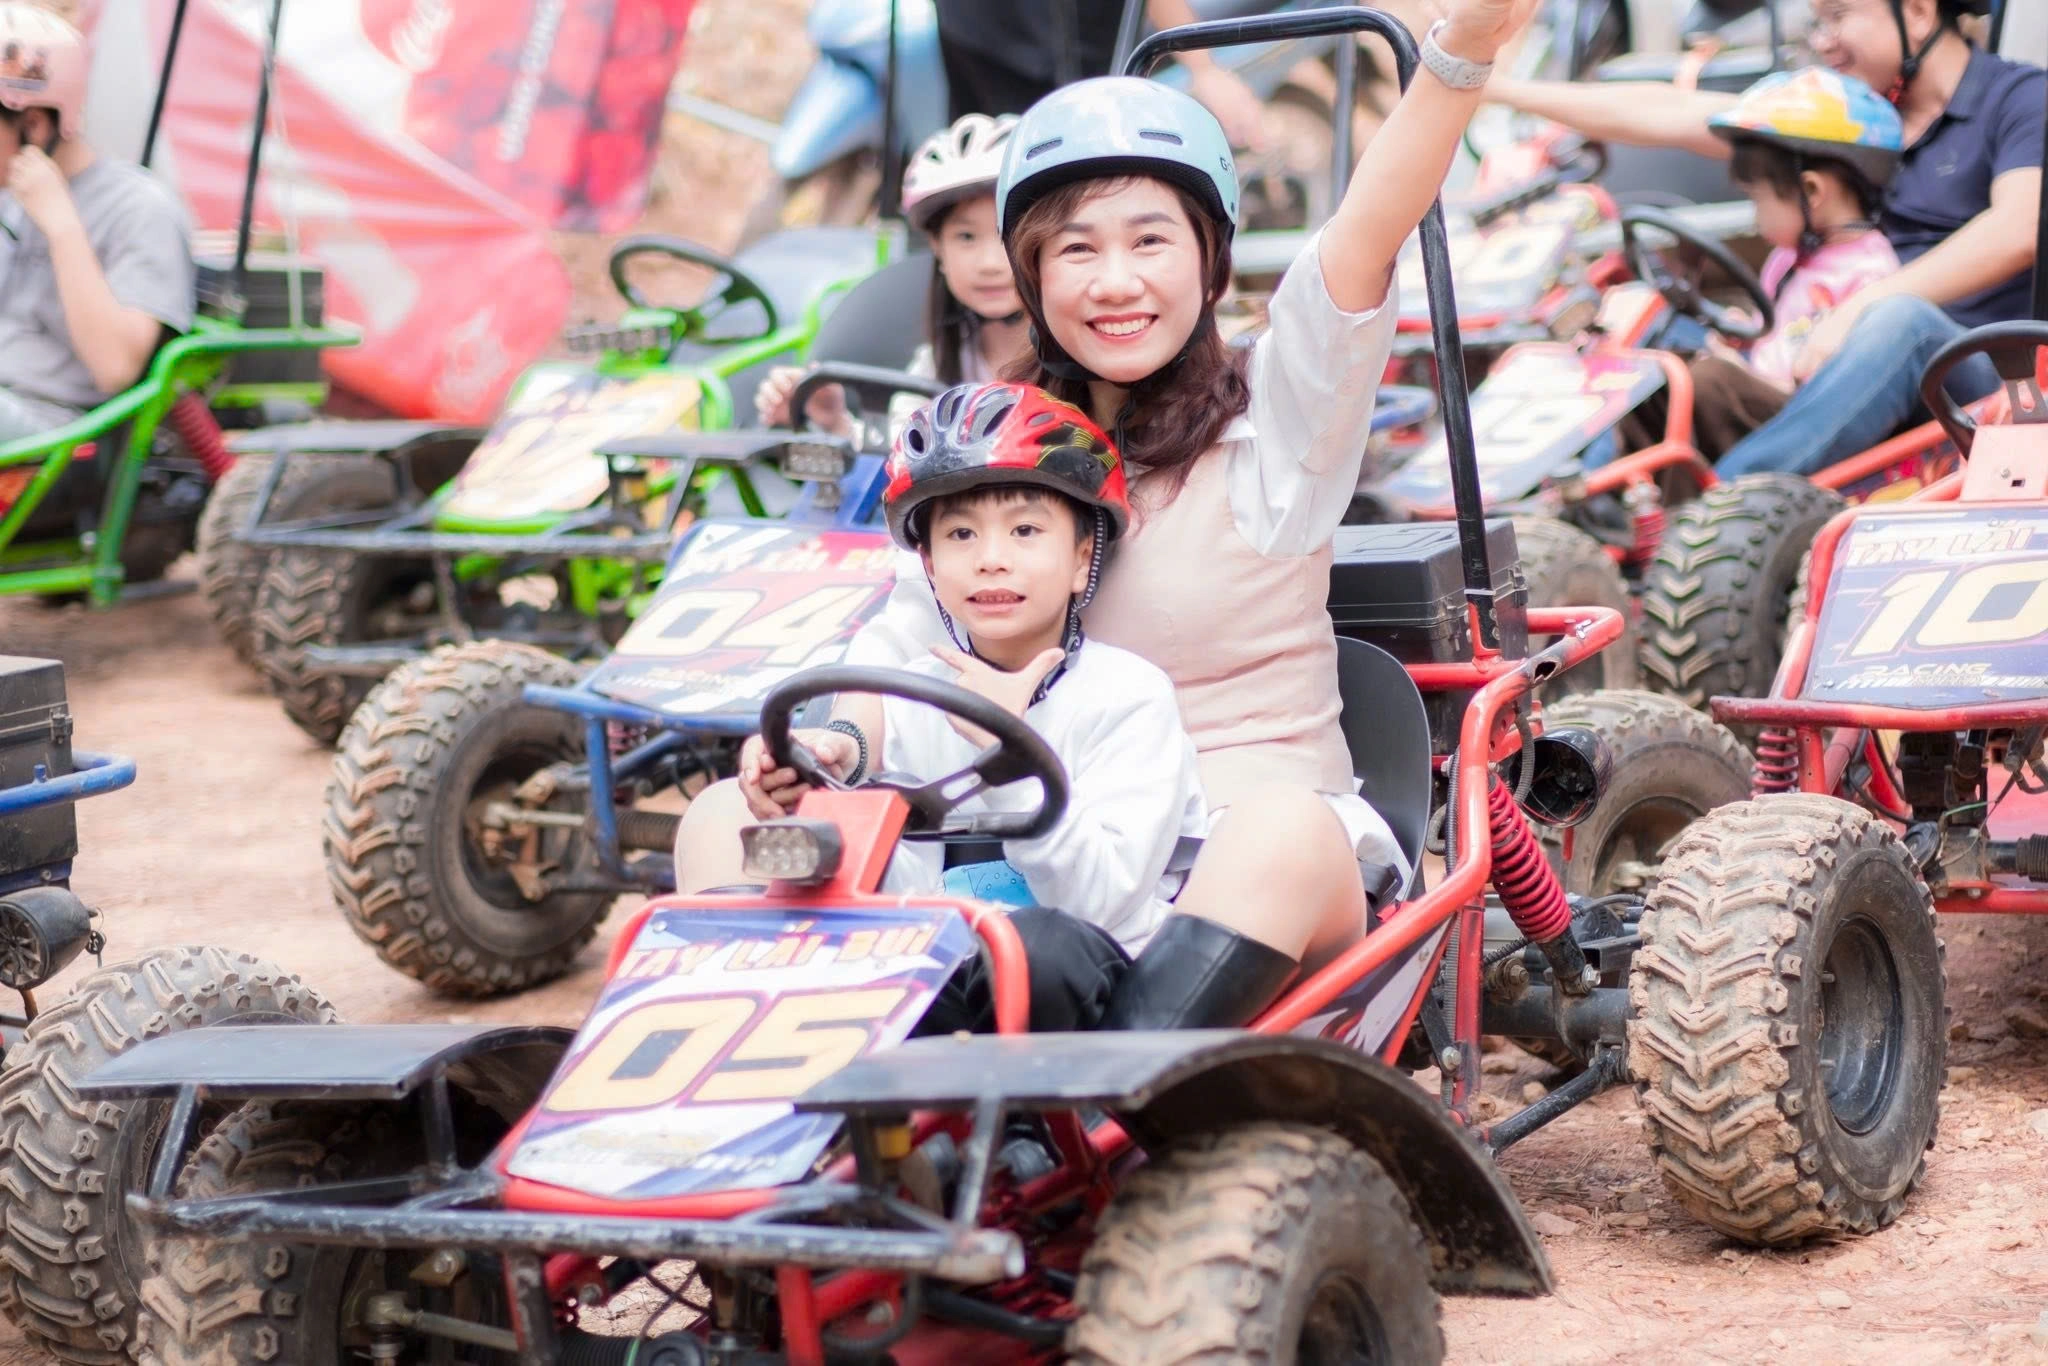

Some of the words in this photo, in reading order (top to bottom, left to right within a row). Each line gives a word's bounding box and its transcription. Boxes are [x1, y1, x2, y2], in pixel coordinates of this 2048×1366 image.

[1847, 536, 1938, 567] TAY
[615, 585, 876, 666] 04
[1850, 560, 2048, 658] 10
[1863, 663, 1993, 677] RACING
[615, 943, 725, 980] TAY
[544, 987, 909, 1112] 05
